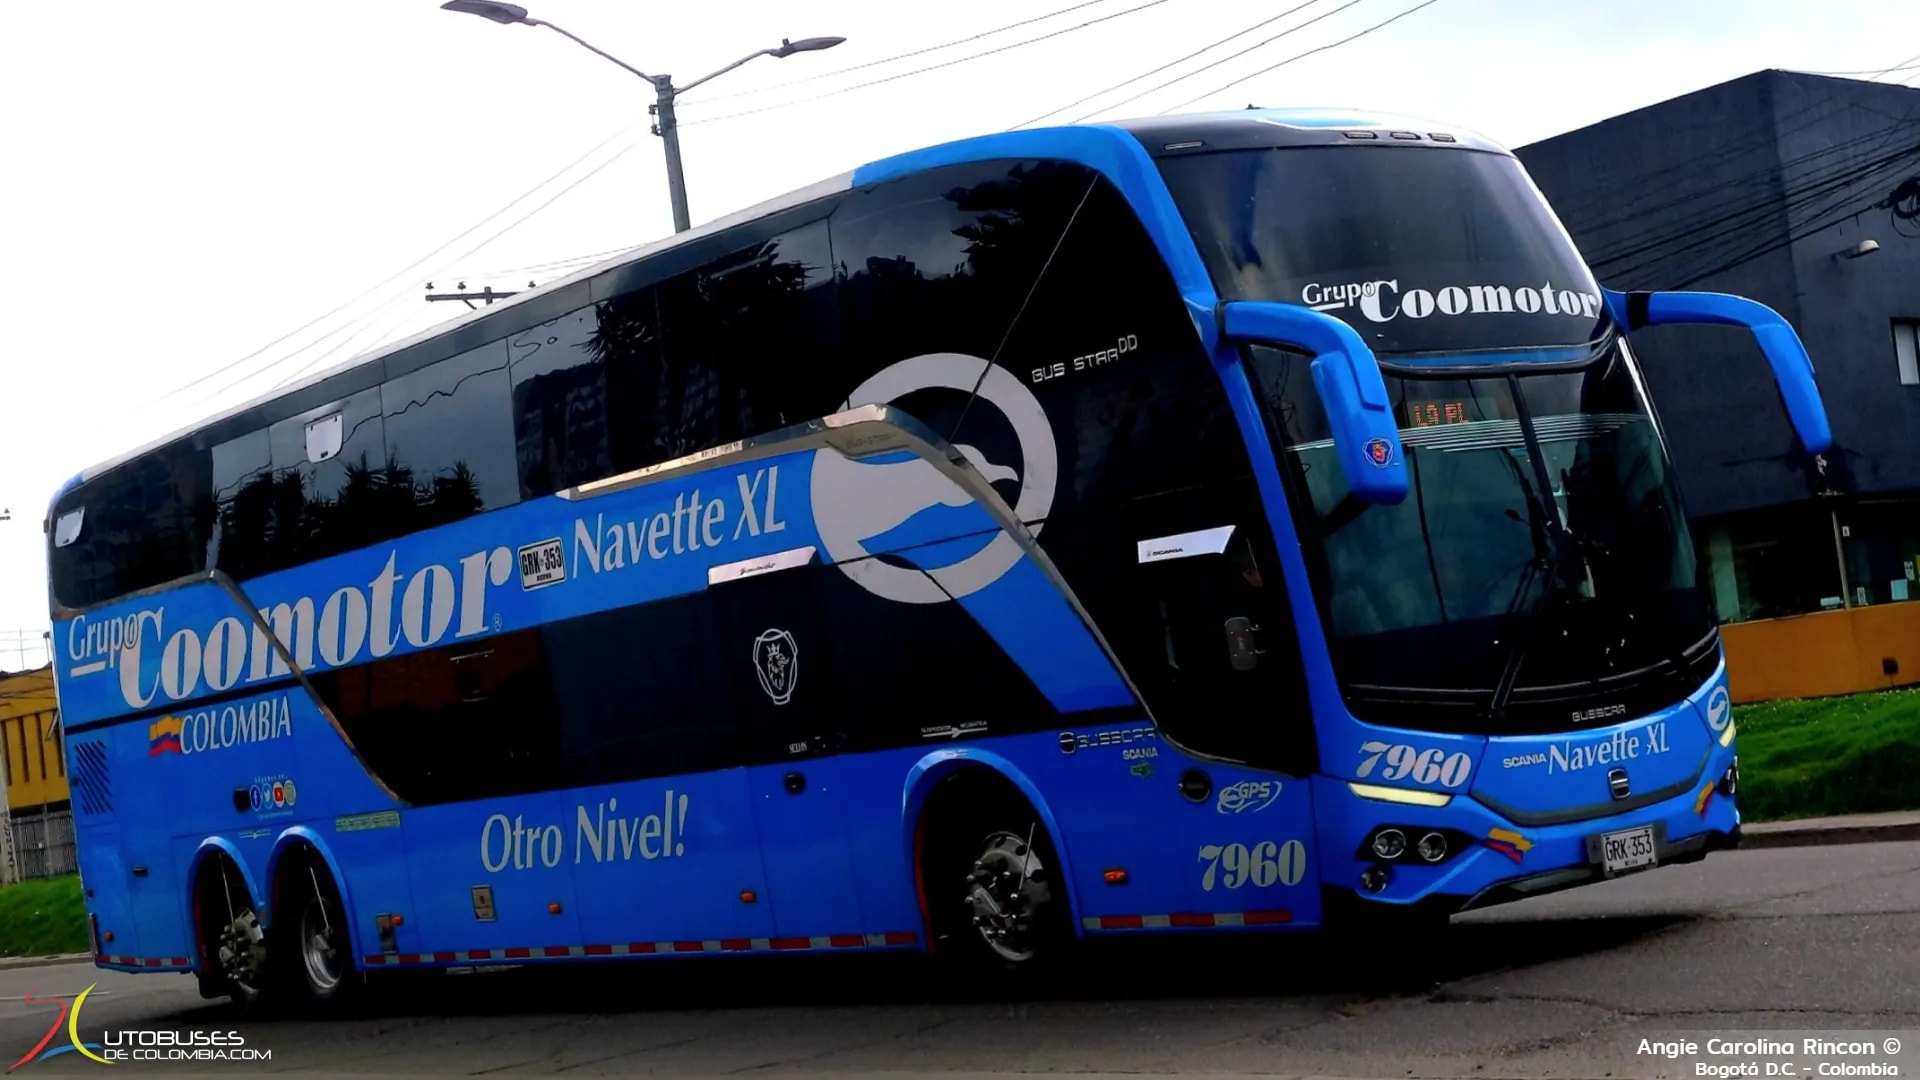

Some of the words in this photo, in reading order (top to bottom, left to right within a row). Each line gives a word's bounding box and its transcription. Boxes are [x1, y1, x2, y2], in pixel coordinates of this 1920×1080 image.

[1302, 281, 1375, 307] Grupo
[1360, 278, 1600, 322] Coomotor
[1031, 362, 1066, 383] BUS
[572, 487, 726, 580] Navette
[732, 465, 786, 541] XL
[68, 613, 140, 669] Grupo
[119, 546, 513, 709] Coomotor
[179, 695, 292, 755] COLOMBIA
[1572, 704, 1626, 722] BUSSCAR
[1122, 747, 1158, 761] SCANIA
[1356, 740, 1472, 788] 7960
[1503, 752, 1548, 769] SCANIA
[1548, 730, 1640, 776] Navette
[1646, 722, 1670, 756] XL
[481, 814, 562, 872] Otro
[574, 790, 689, 864] Nivel!
[1198, 839, 1307, 891] 7960
